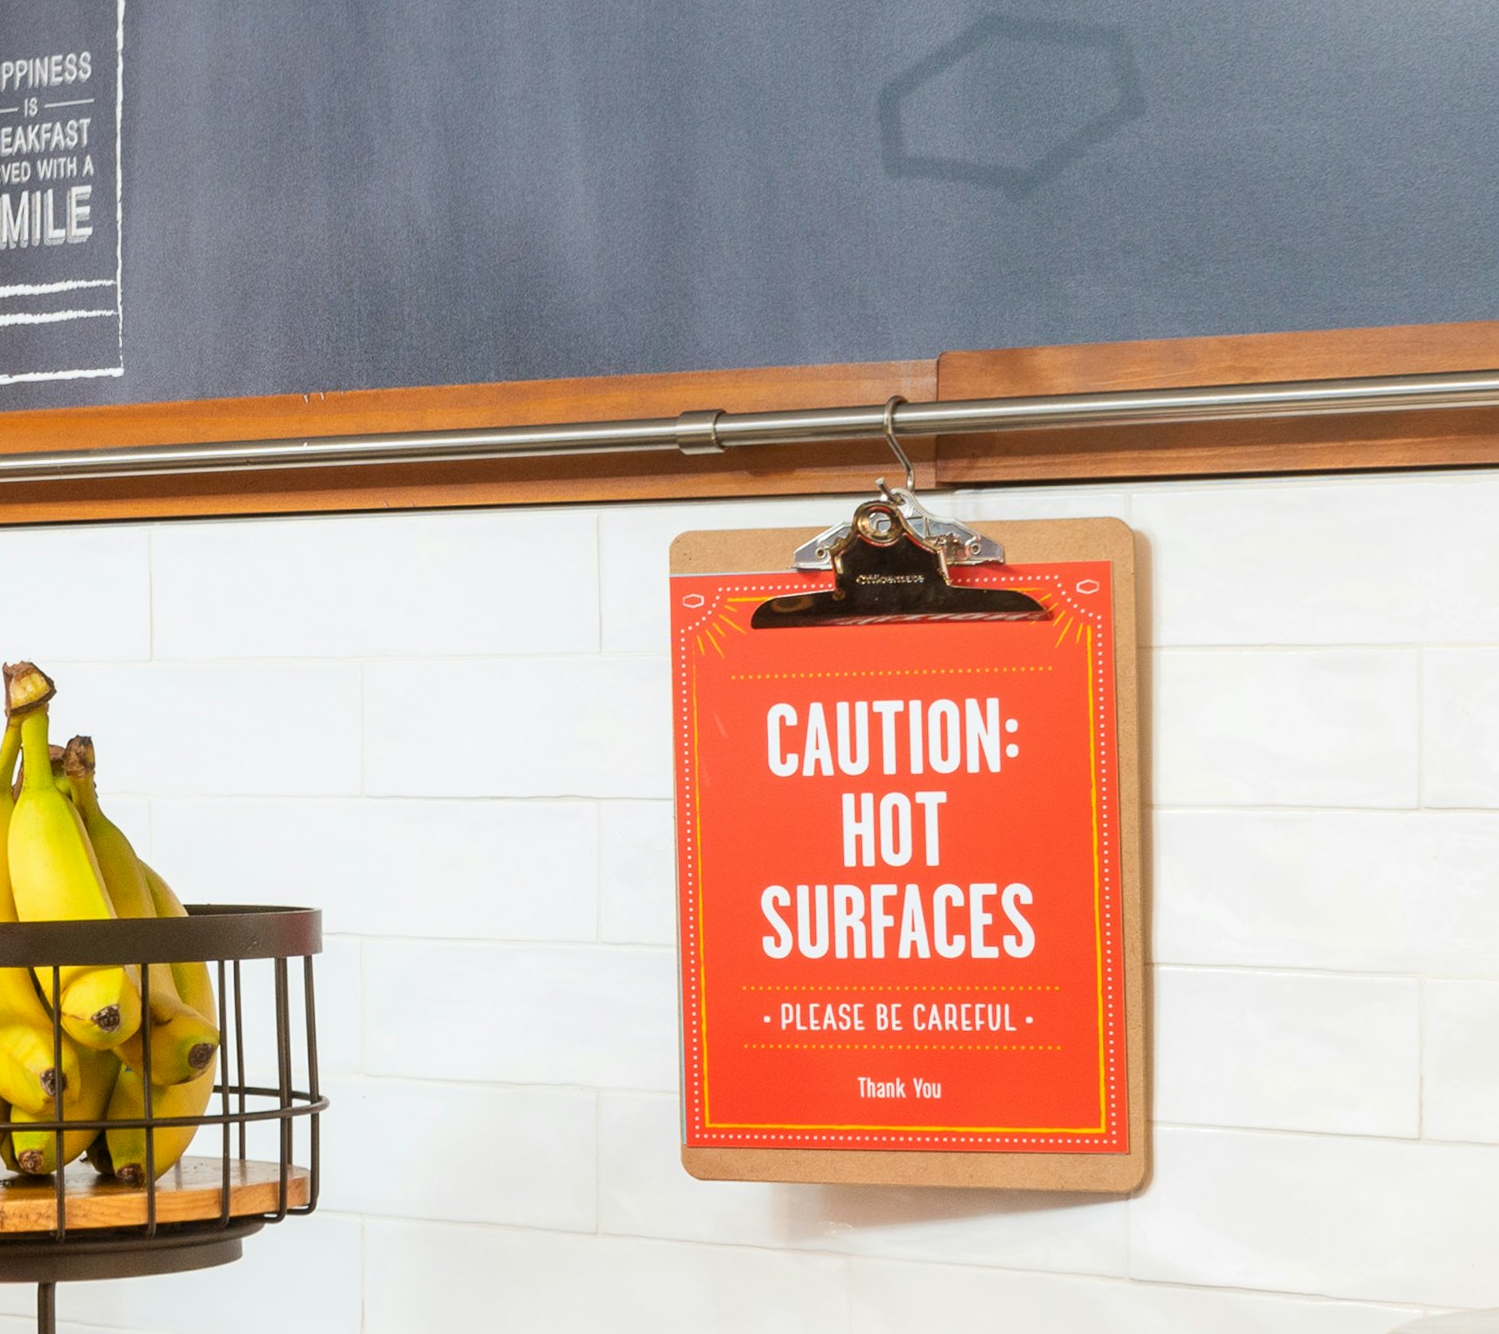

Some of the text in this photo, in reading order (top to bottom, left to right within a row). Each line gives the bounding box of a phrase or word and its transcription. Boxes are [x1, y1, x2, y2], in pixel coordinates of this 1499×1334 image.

[24, 98, 38, 118] IS
[37, 157, 77, 180] WITH
[81, 155, 94, 177] A
[766, 696, 1019, 778] CAUTION:
[841, 791, 947, 868] HOT
[760, 882, 1036, 959] SURFACES
[780, 1002, 1017, 1031] PLEASE BE CAREFUL
[858, 1077, 942, 1099] Thank You
